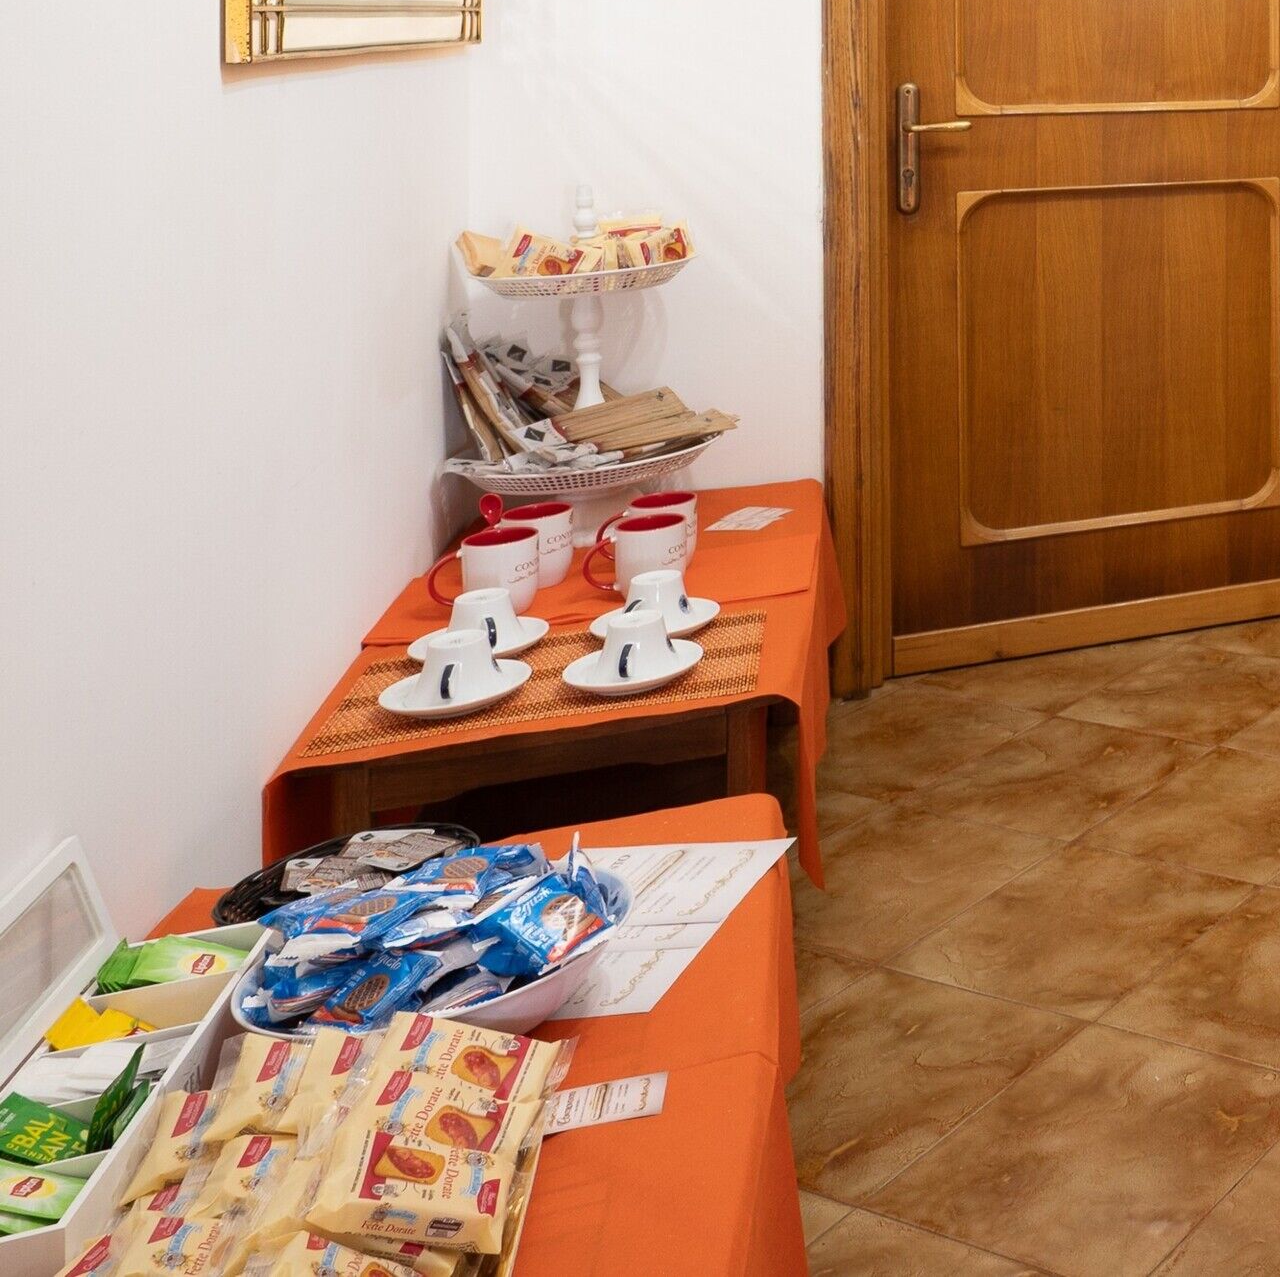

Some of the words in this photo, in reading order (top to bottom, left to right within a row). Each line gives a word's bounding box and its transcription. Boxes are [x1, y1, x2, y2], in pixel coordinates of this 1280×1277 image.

[193, 954, 212, 973] Lipton
[439, 1029, 464, 1061] Dorate
[416, 1087, 443, 1121] Dorate
[11, 1177, 43, 1197] Lipton
[442, 1168, 459, 1199] Dorate
[200, 1222, 221, 1253] Dorat
[384, 1223, 417, 1235] Dorate
